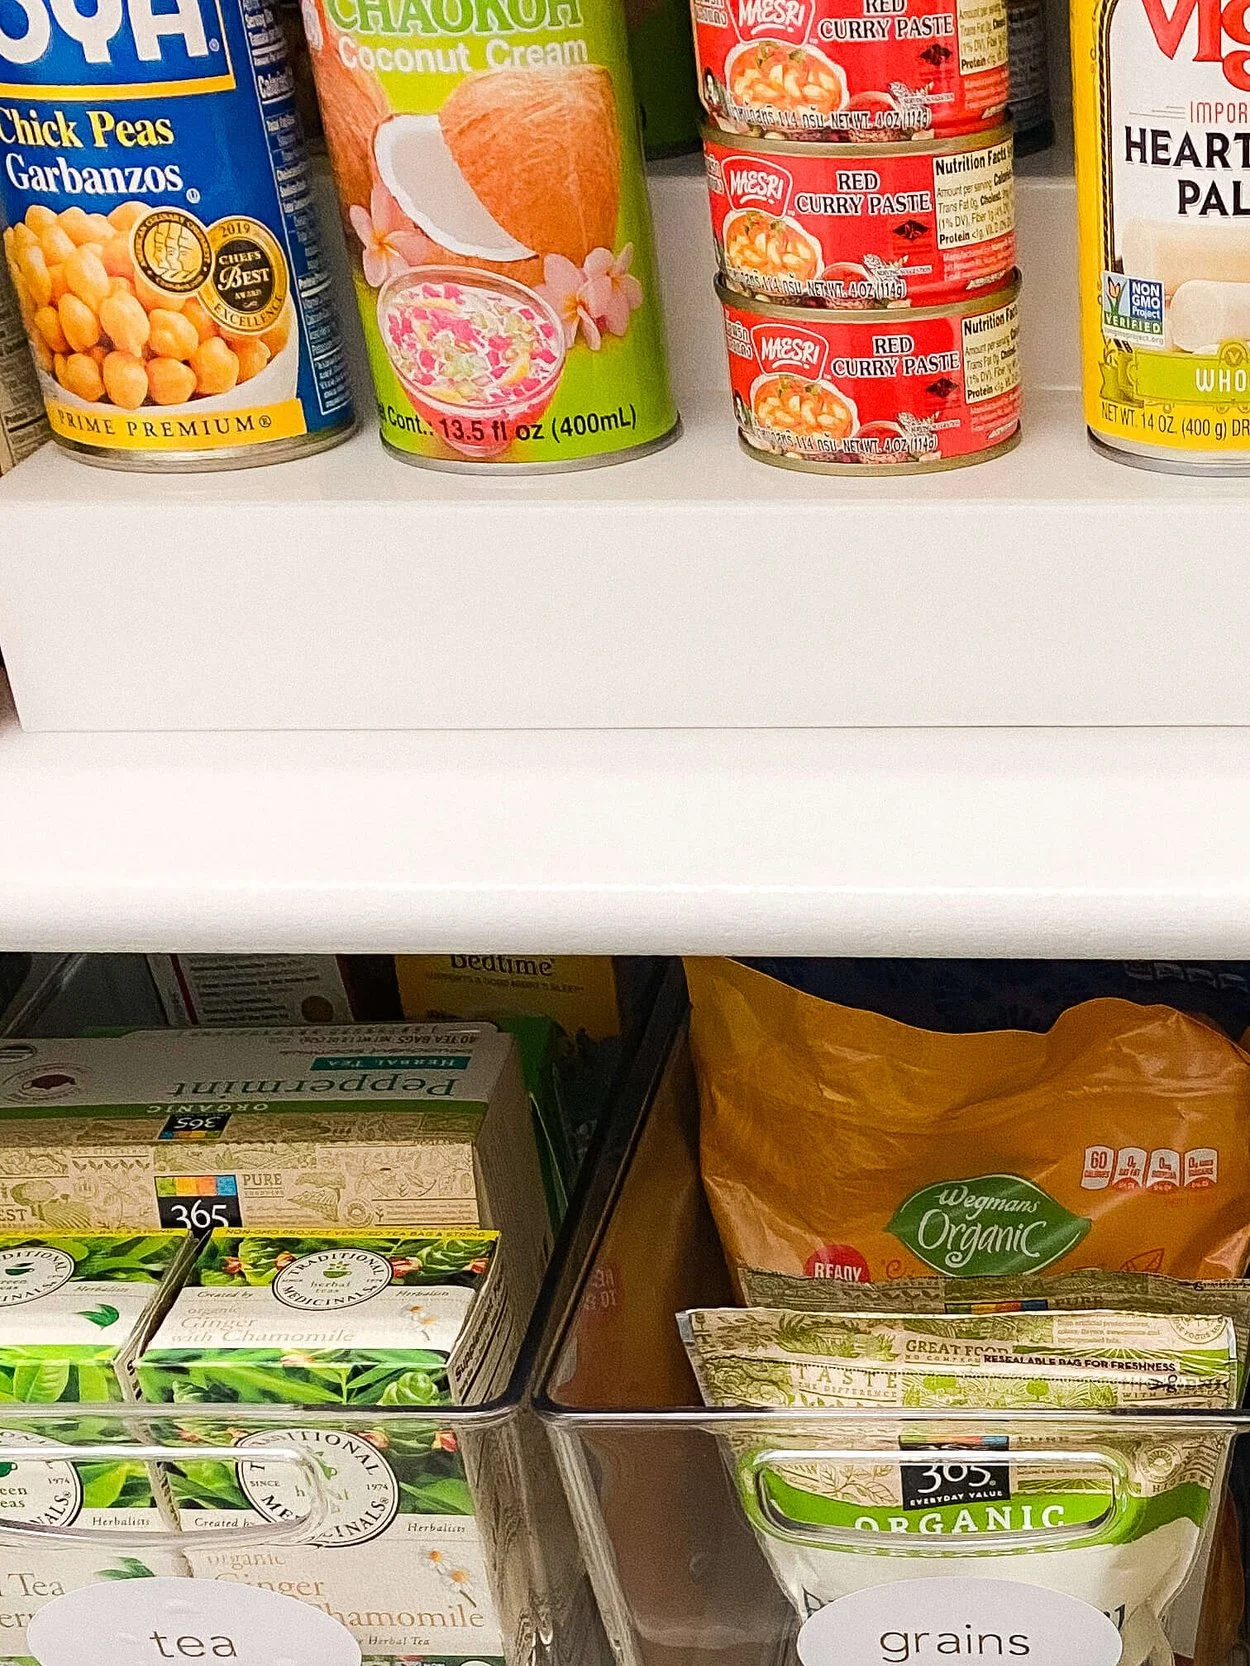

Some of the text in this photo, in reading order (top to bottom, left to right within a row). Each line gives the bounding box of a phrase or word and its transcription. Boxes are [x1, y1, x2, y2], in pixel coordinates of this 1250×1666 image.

[820, 13, 954, 40] CURRY PASTE
[338, 38, 589, 75] Coconut Cream
[0, 107, 175, 149] Chick Peas
[5, 153, 184, 195] Garbanzos
[935, 154, 986, 176] Nutrition
[729, 167, 784, 202] MAESRI
[836, 170, 879, 192] RED
[796, 191, 932, 215] CURRY PASTE
[220, 222, 251, 238] 2019
[218, 250, 263, 265] CHEFS
[761, 335, 820, 370] MAESRI
[873, 335, 915, 355] RED
[831, 353, 962, 378] CURRY PASTE
[56, 408, 116, 435] PRIME
[438, 404, 638, 445] 13.5 fl oz (400mL)
[1101, 402, 1120, 423] NET
[1141, 411, 1155, 429] 14
[1181, 415, 1210, 438] (400
[1213, 417, 1227, 441] g)
[167, 1073, 460, 1098] Peppermint
[147, 1103, 269, 1114] ORGANIC
[243, 1173, 282, 1187] PURE
[171, 1200, 230, 1229] 365
[935, 1185, 1041, 1222] Wegmans
[918, 1208, 1047, 1268] Organic
[285, 1248, 388, 1281] TRADITIONAL
[282, 1284, 380, 1308] MEDICINALS
[982, 1353, 1176, 1373] RESEALABLE BAG FOR FRESHNESS
[909, 1488, 1004, 1507] EVERYDAY VALUE
[149, 1630, 238, 1660] tea
[880, 1622, 1031, 1664] grains
